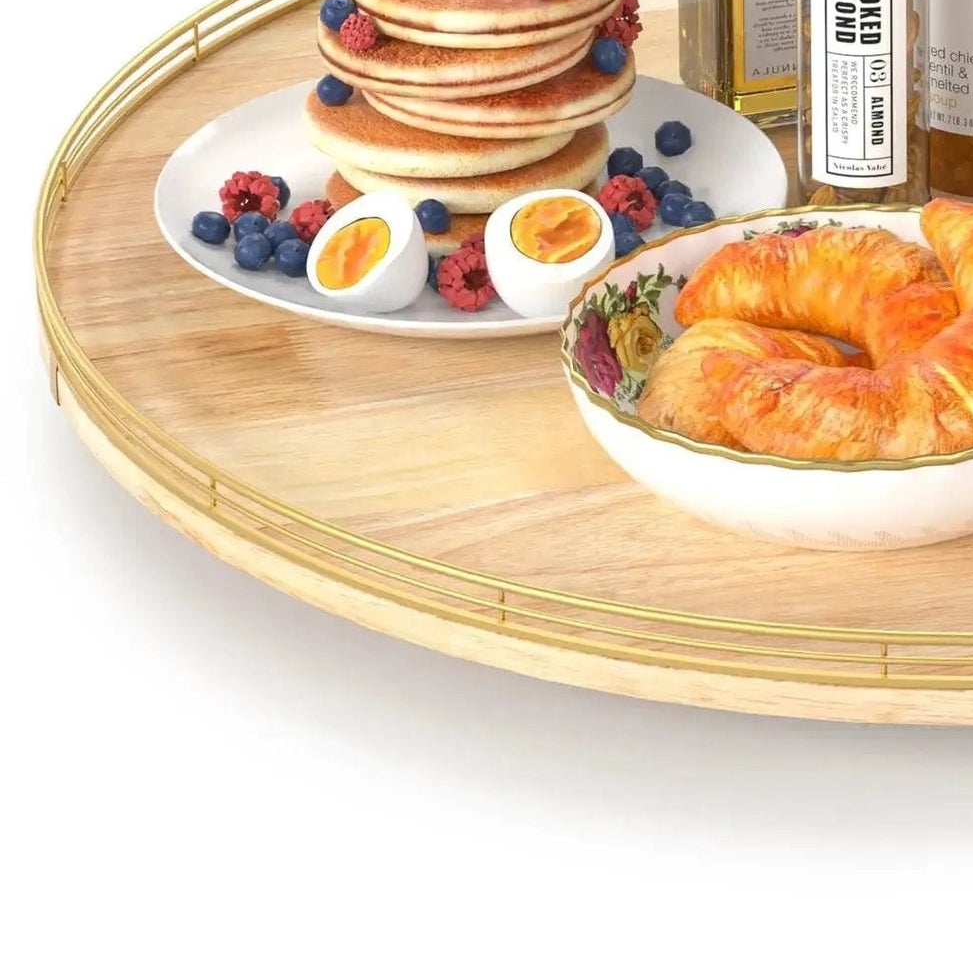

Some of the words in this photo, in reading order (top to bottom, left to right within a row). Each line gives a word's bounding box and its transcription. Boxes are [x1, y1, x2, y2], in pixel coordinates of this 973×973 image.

[851, 60, 858, 73] WE
[870, 59, 887, 83] 03
[958, 67, 968, 79] &
[851, 75, 859, 125] RECOMMEND
[871, 96, 884, 146] ALMOND
